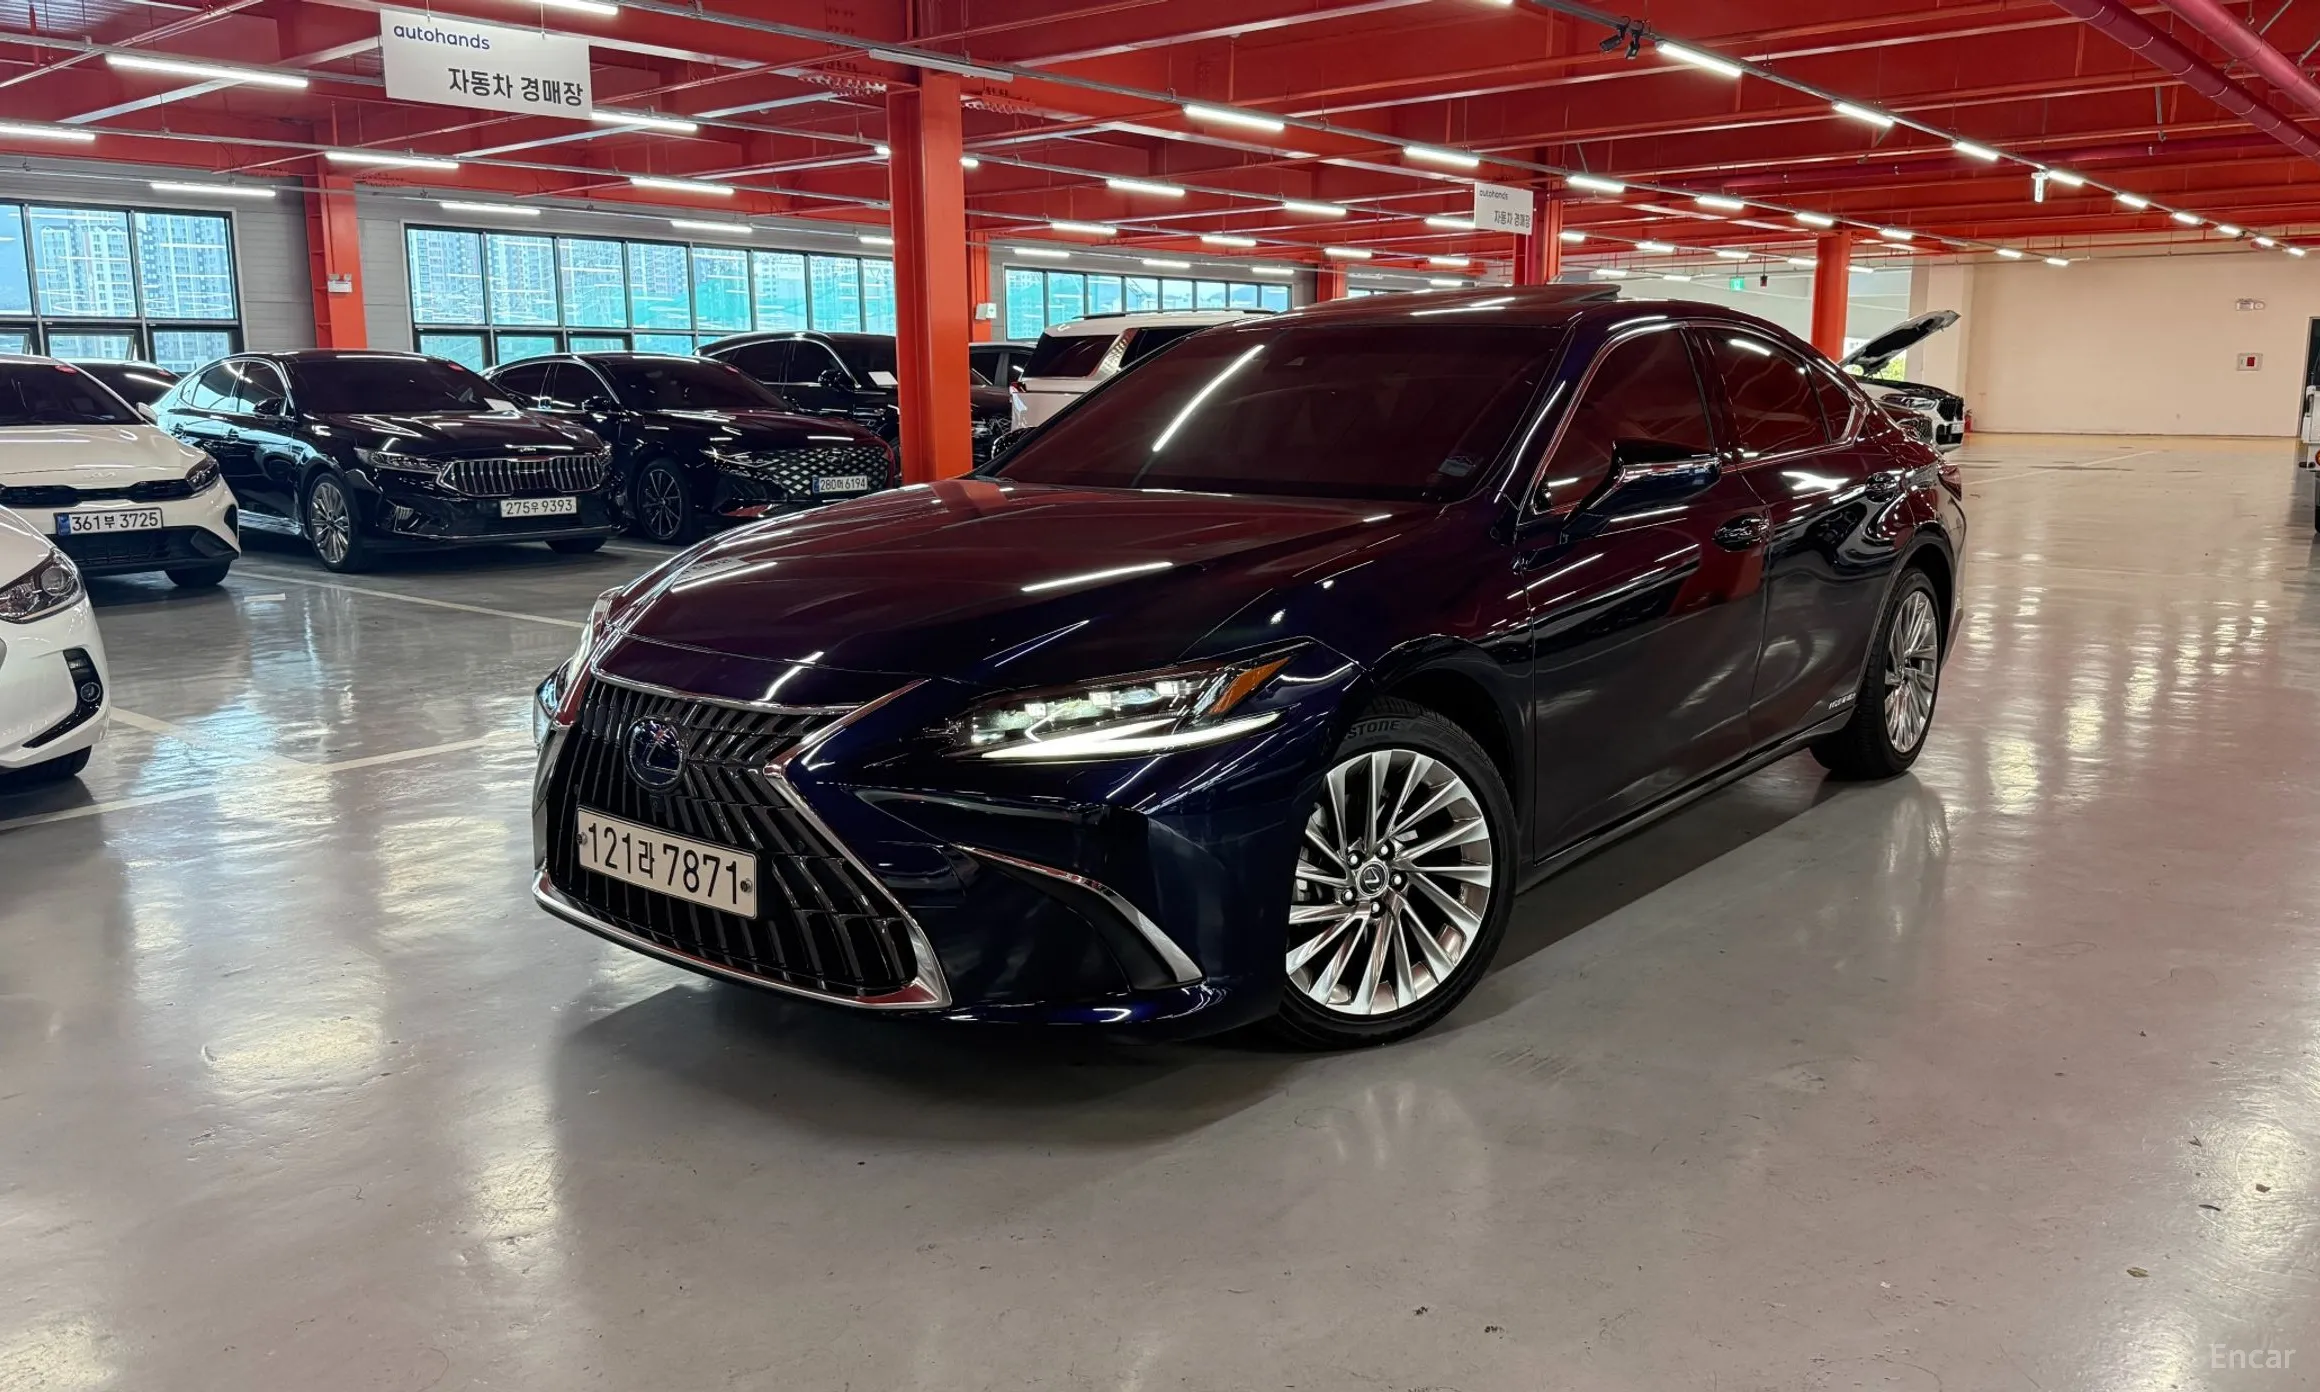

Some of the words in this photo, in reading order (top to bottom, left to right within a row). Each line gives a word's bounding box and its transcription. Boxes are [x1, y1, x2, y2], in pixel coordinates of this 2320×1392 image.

[393, 25, 491, 50] autohands
[448, 67, 513, 99] 자동차
[520, 76, 584, 106] 경매장
[541, 499, 573, 513] 9393
[71, 515, 116, 532] 361부
[119, 511, 159, 529] 3725
[1346, 719, 1401, 740] STONE
[588, 822, 655, 880] 121라
[663, 843, 737, 905] 7871
